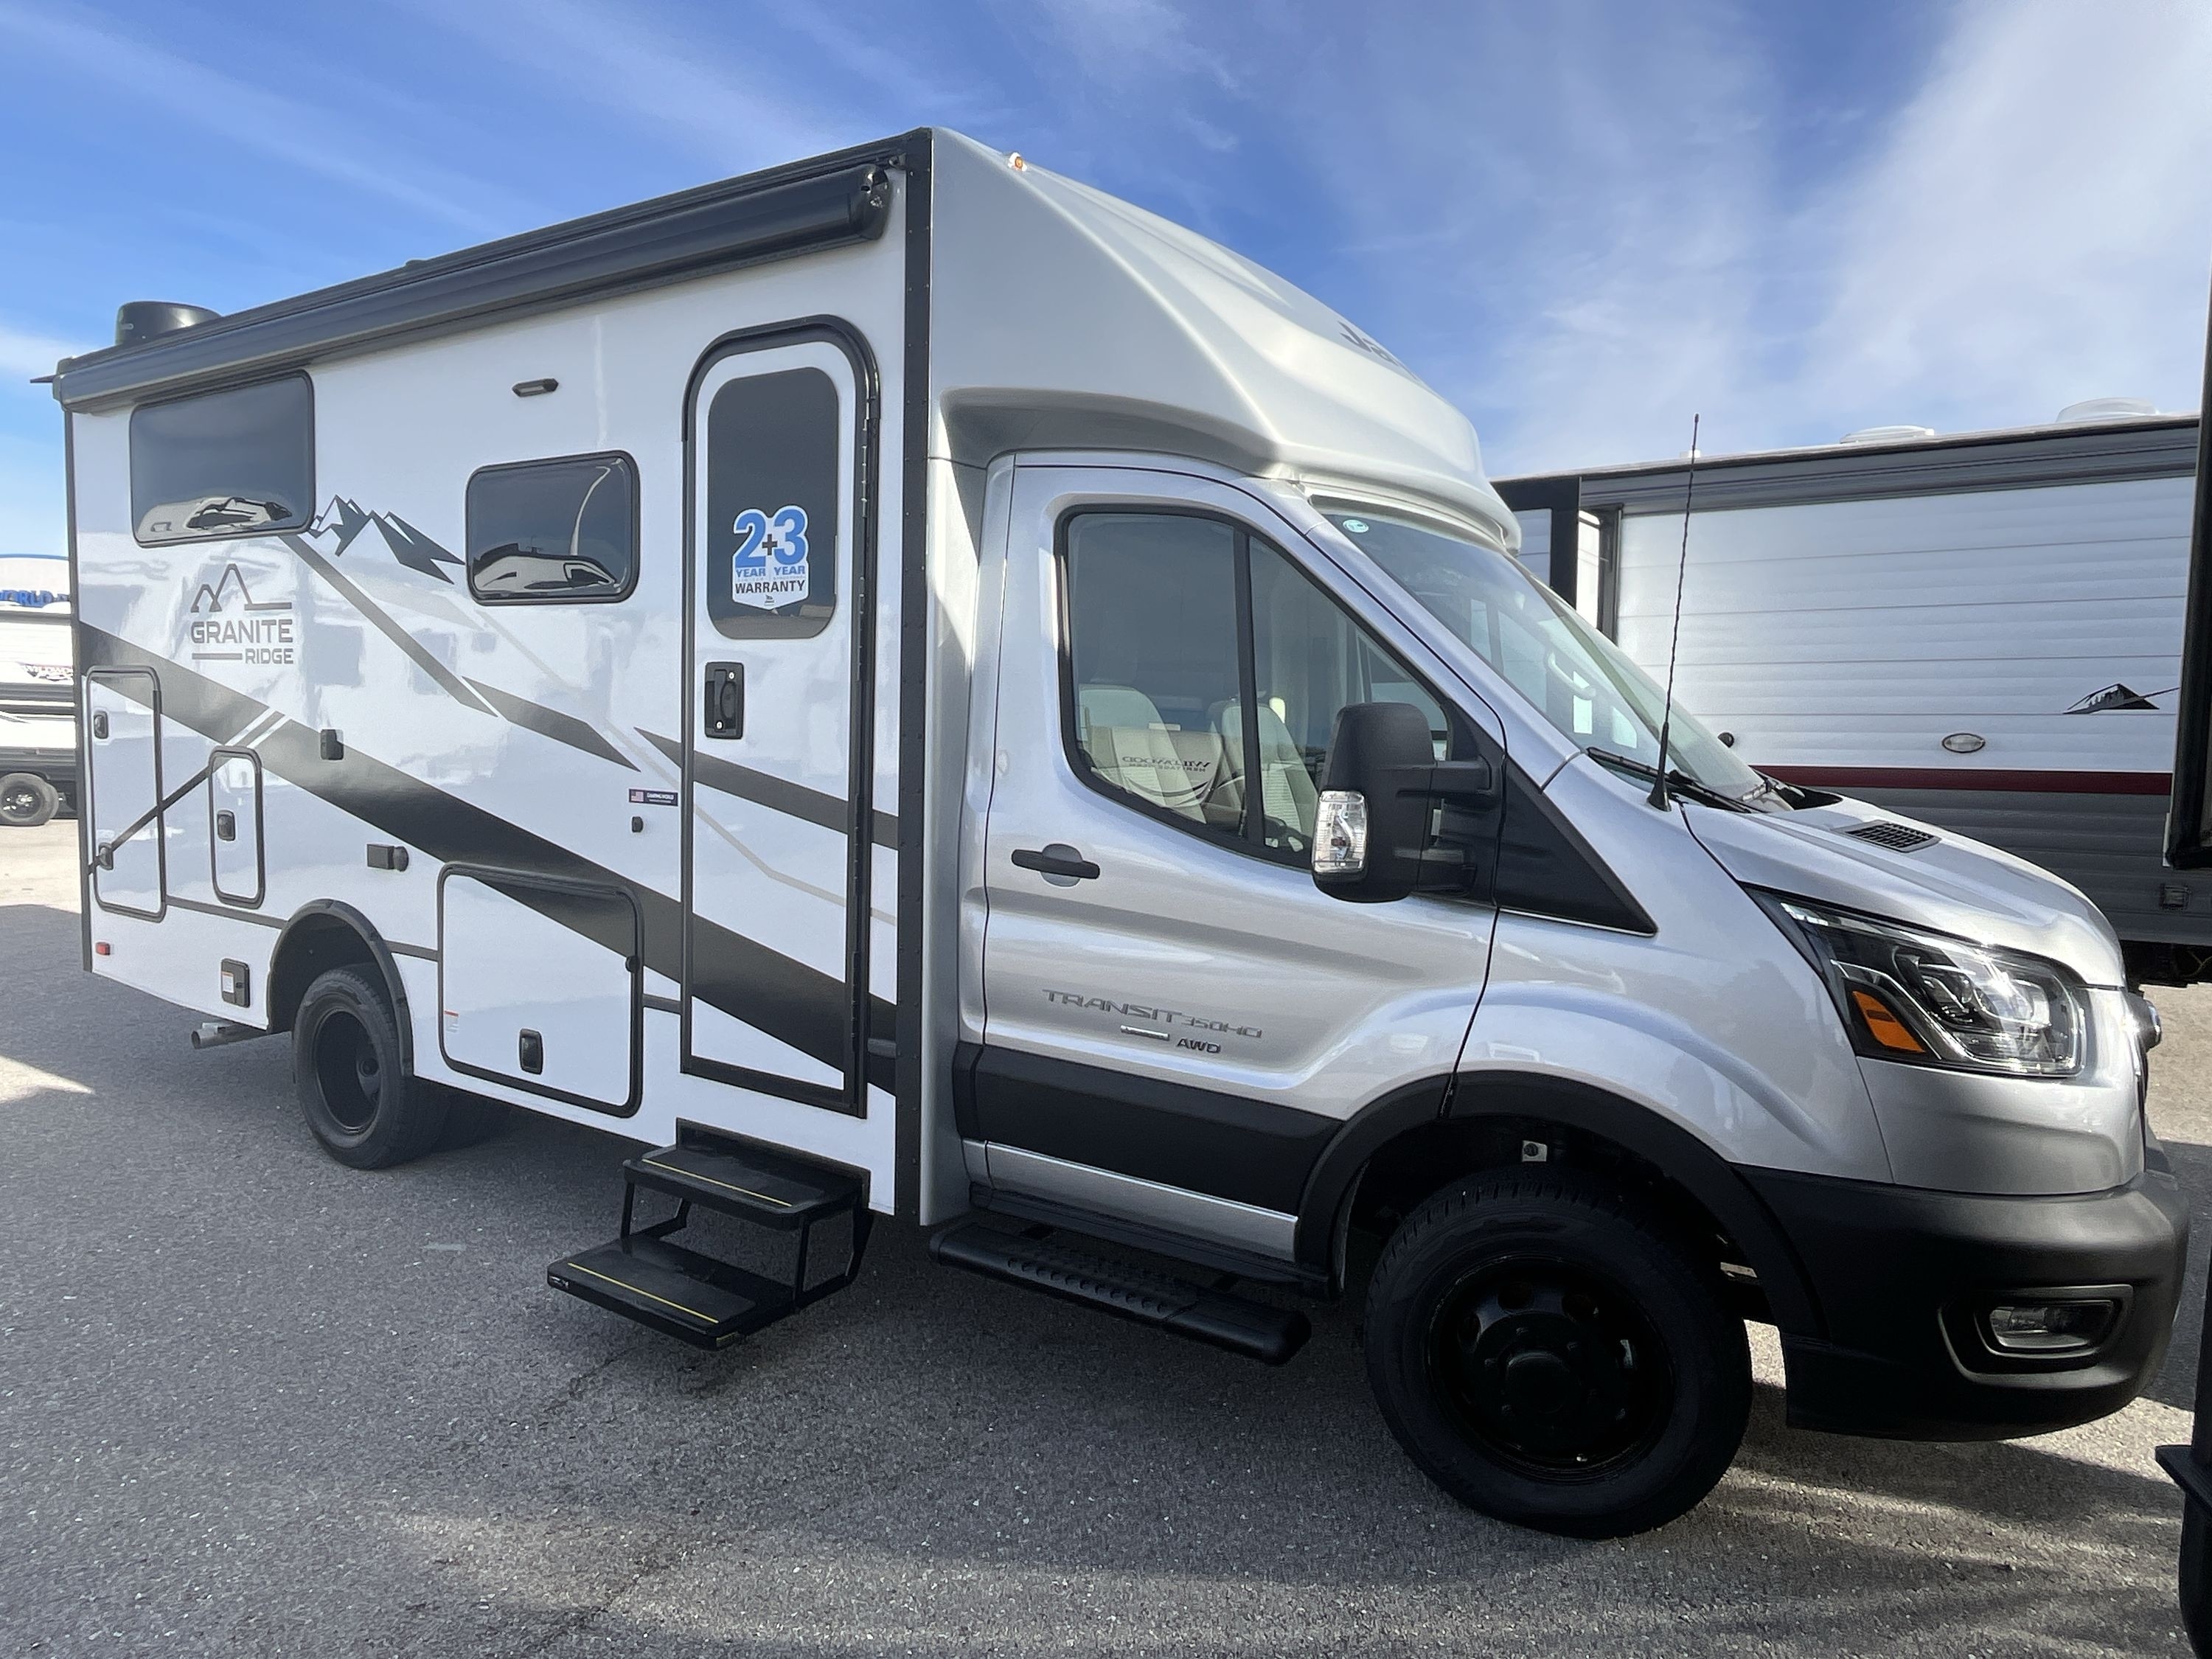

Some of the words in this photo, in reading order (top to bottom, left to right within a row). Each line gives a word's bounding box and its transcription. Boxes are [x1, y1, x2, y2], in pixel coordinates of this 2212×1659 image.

[736, 568, 766, 577] YEAR
[773, 566, 805, 575] YEAR
[735, 580, 805, 594] WARRANTY
[190, 619, 293, 644] GRANITE
[245, 648, 294, 664] RIDGE
[1042, 989, 1183, 1023] TRANSIT
[1177, 1037, 1221, 1054] AWD
